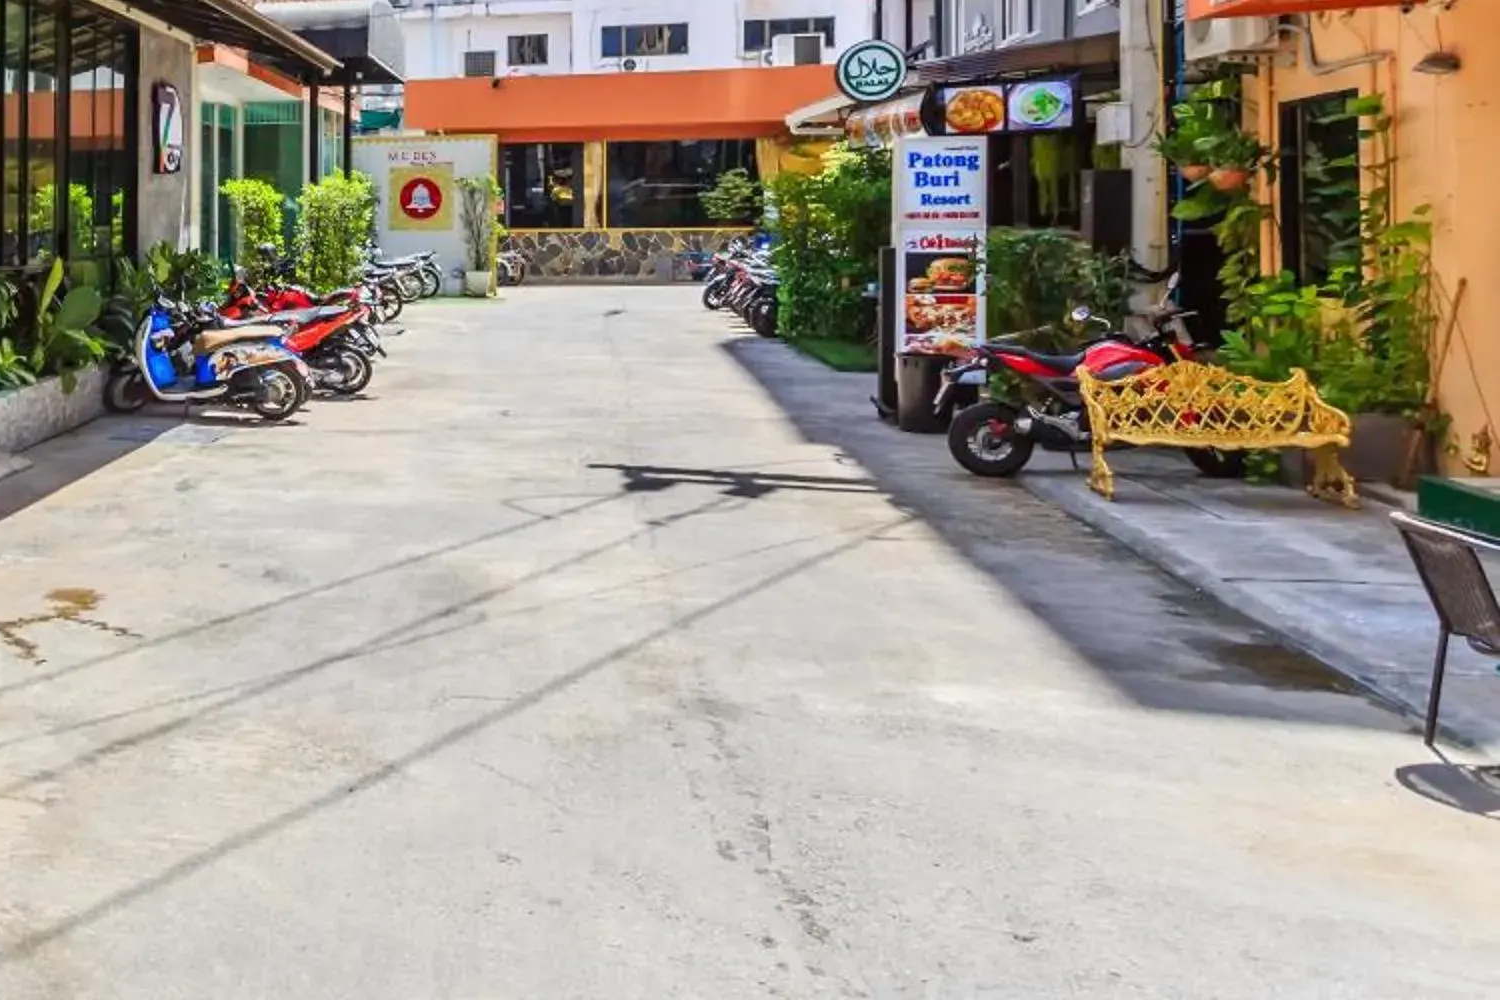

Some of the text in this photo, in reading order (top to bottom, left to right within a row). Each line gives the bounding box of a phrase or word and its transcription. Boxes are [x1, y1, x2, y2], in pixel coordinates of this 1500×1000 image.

[908, 152, 980, 171] Patong
[915, 170, 960, 187] Buri
[921, 193, 972, 206] Resort
